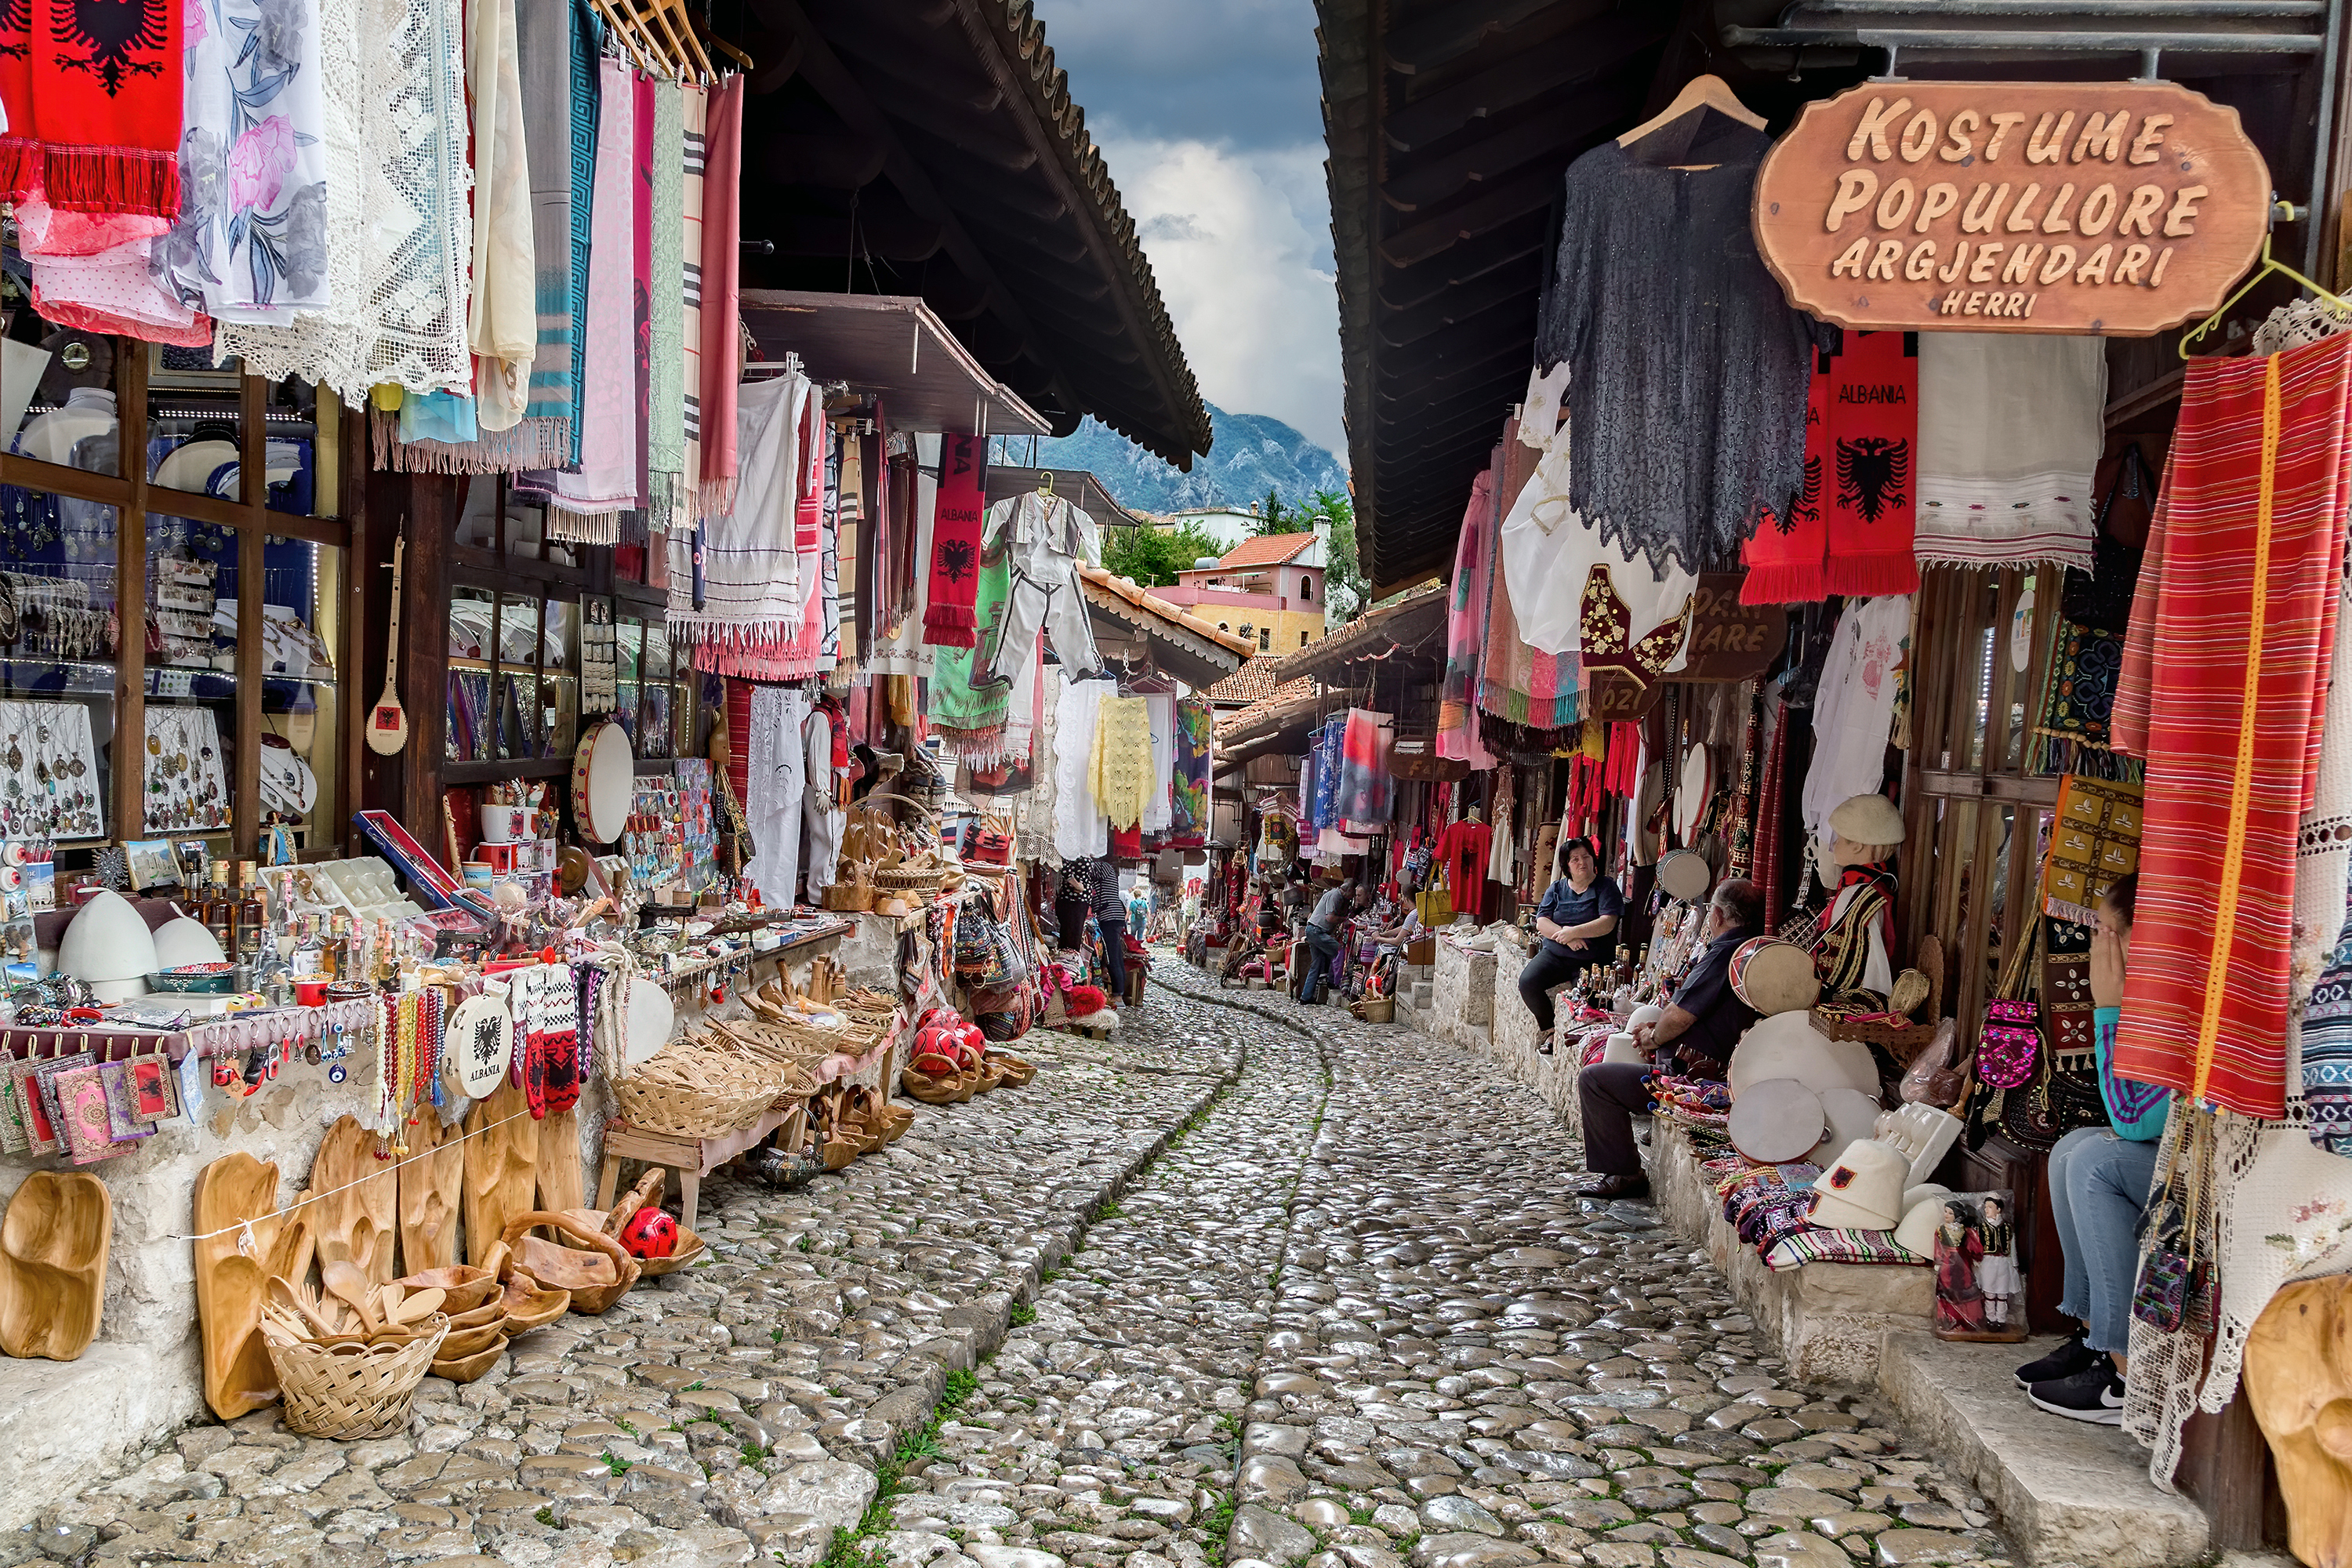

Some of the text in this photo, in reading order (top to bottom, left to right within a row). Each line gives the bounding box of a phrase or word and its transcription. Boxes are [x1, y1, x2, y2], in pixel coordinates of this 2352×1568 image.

[1846, 96, 2174, 165] KOSTUME
[1825, 168, 2209, 238] POPULLORE
[1831, 236, 2174, 288] ARGJENDARI
[1942, 289, 2037, 318] HERRI
[1838, 384, 1907, 404] ALBANIA
[940, 508, 978, 522] ALBANIA
[470, 1064, 500, 1082] ALBANIA
